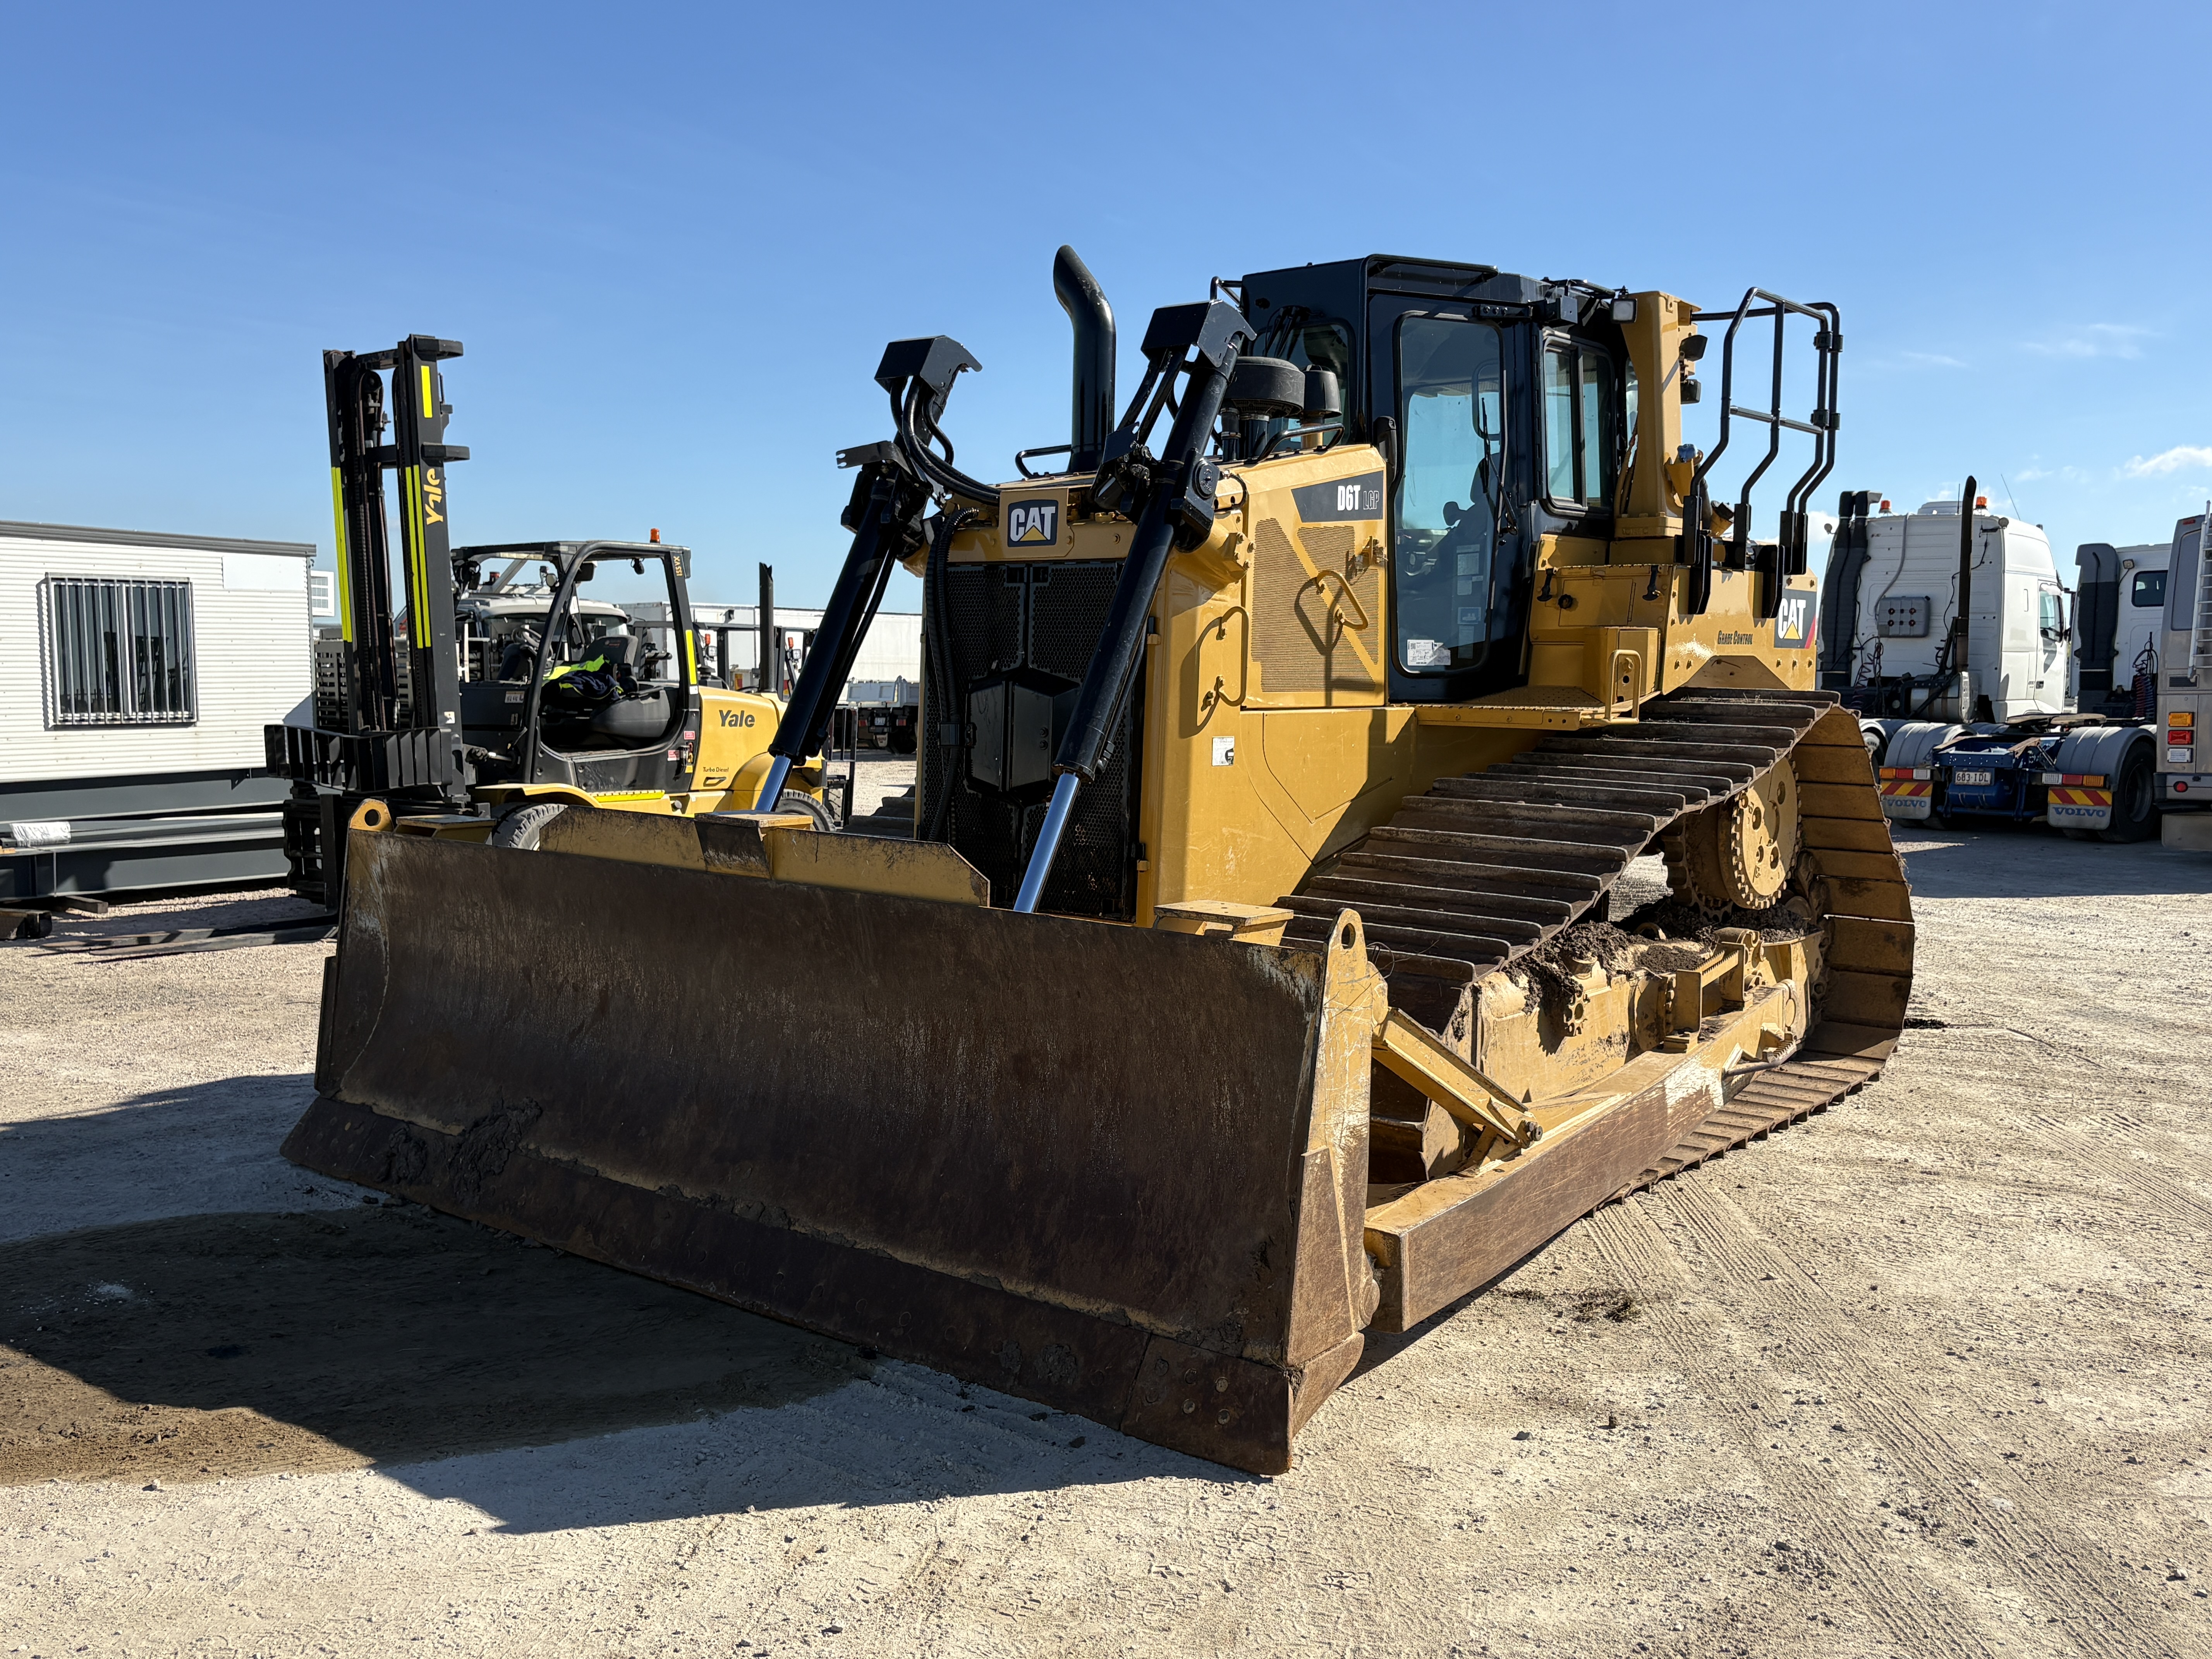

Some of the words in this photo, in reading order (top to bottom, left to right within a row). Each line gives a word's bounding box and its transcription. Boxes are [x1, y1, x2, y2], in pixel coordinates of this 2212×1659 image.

[424, 468, 444, 525] Yale
[1337, 484, 1360, 511] D6T
[1363, 490, 1379, 510] LGP
[1010, 506, 1056, 542] CAT
[1778, 598, 1806, 639] CAT
[719, 709, 755, 728] Yale
[1887, 799, 1927, 807] VOLVO
[2053, 807, 2106, 817] VOLVO
